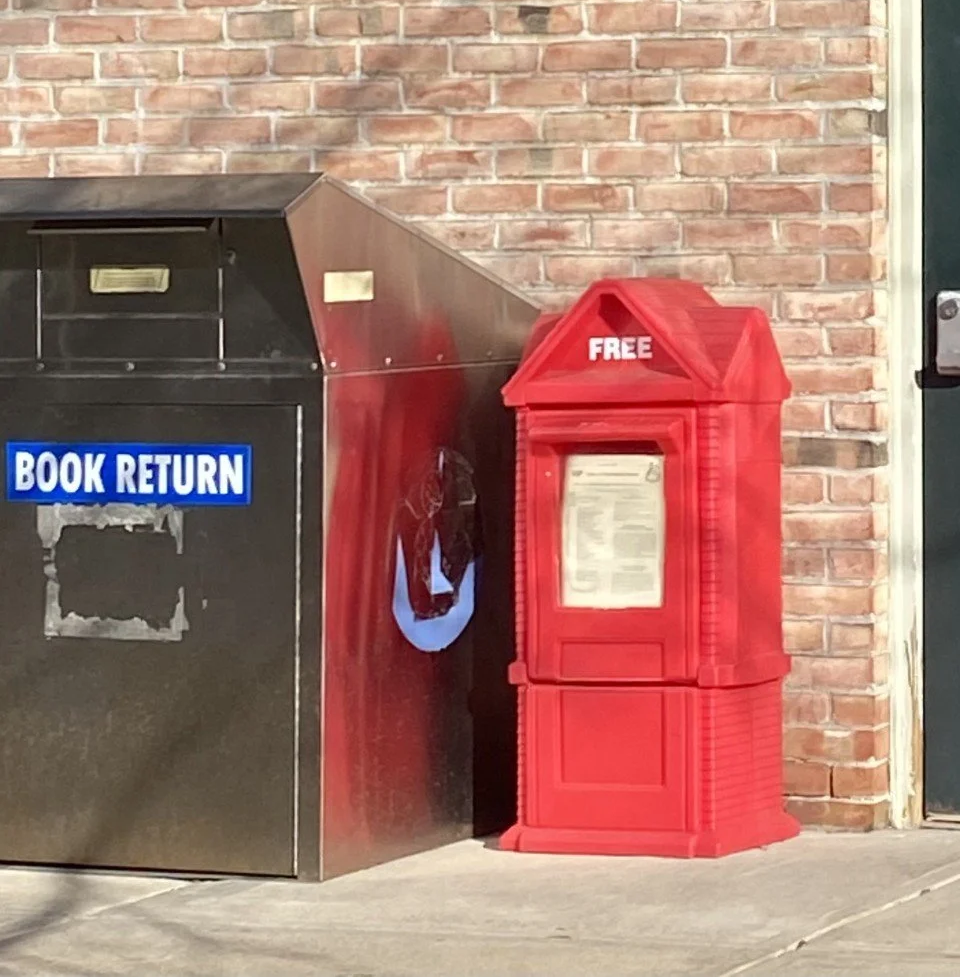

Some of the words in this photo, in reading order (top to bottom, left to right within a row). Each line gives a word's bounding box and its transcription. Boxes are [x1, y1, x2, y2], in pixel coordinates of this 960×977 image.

[589, 337, 653, 361] FREE
[15, 452, 105, 493] BOOK
[117, 454, 243, 495] RETURN
